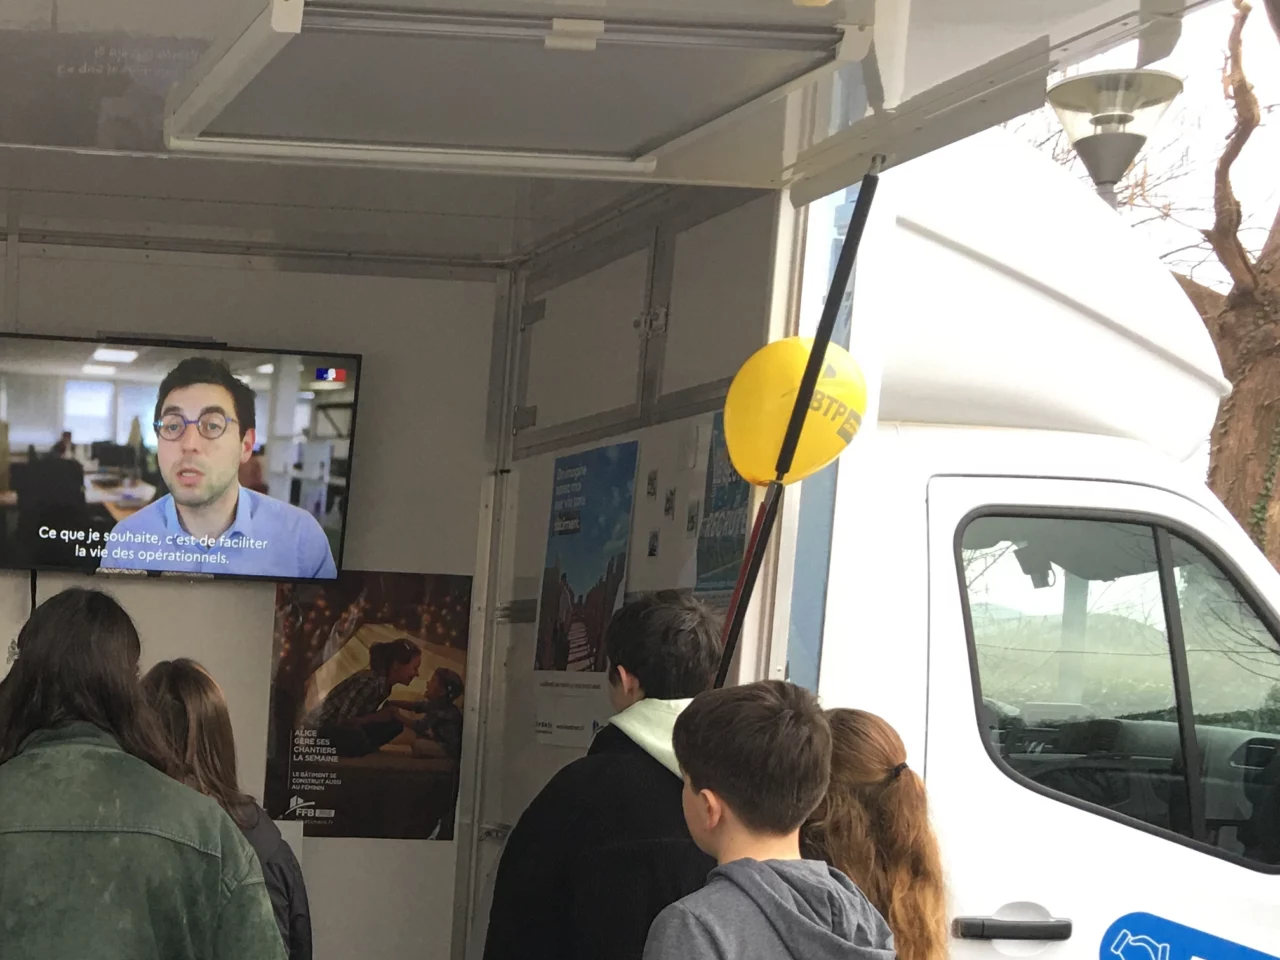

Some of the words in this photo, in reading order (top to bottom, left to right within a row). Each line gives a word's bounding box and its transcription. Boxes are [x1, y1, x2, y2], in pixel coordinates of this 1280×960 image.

[809, 388, 849, 422] BTP
[38, 526, 57, 539] Ce
[60, 528, 85, 543] que
[86, 528, 101, 544] je
[103, 530, 162, 546] souhaite,
[166, 533, 196, 548] c'est
[199, 534, 216, 548] de
[219, 535, 268, 549] faciliter
[75, 544, 87, 557] la
[90, 546, 109, 559] vie
[112, 547, 134, 560] des
[138, 549, 230, 565] opérationnels.
[294, 729, 318, 737] ALICE
[316, 738, 331, 746] SES
[293, 745, 337, 754] CHANTIERS
[304, 755, 339, 763] SEMAINE
[295, 808, 315, 817] FFB
